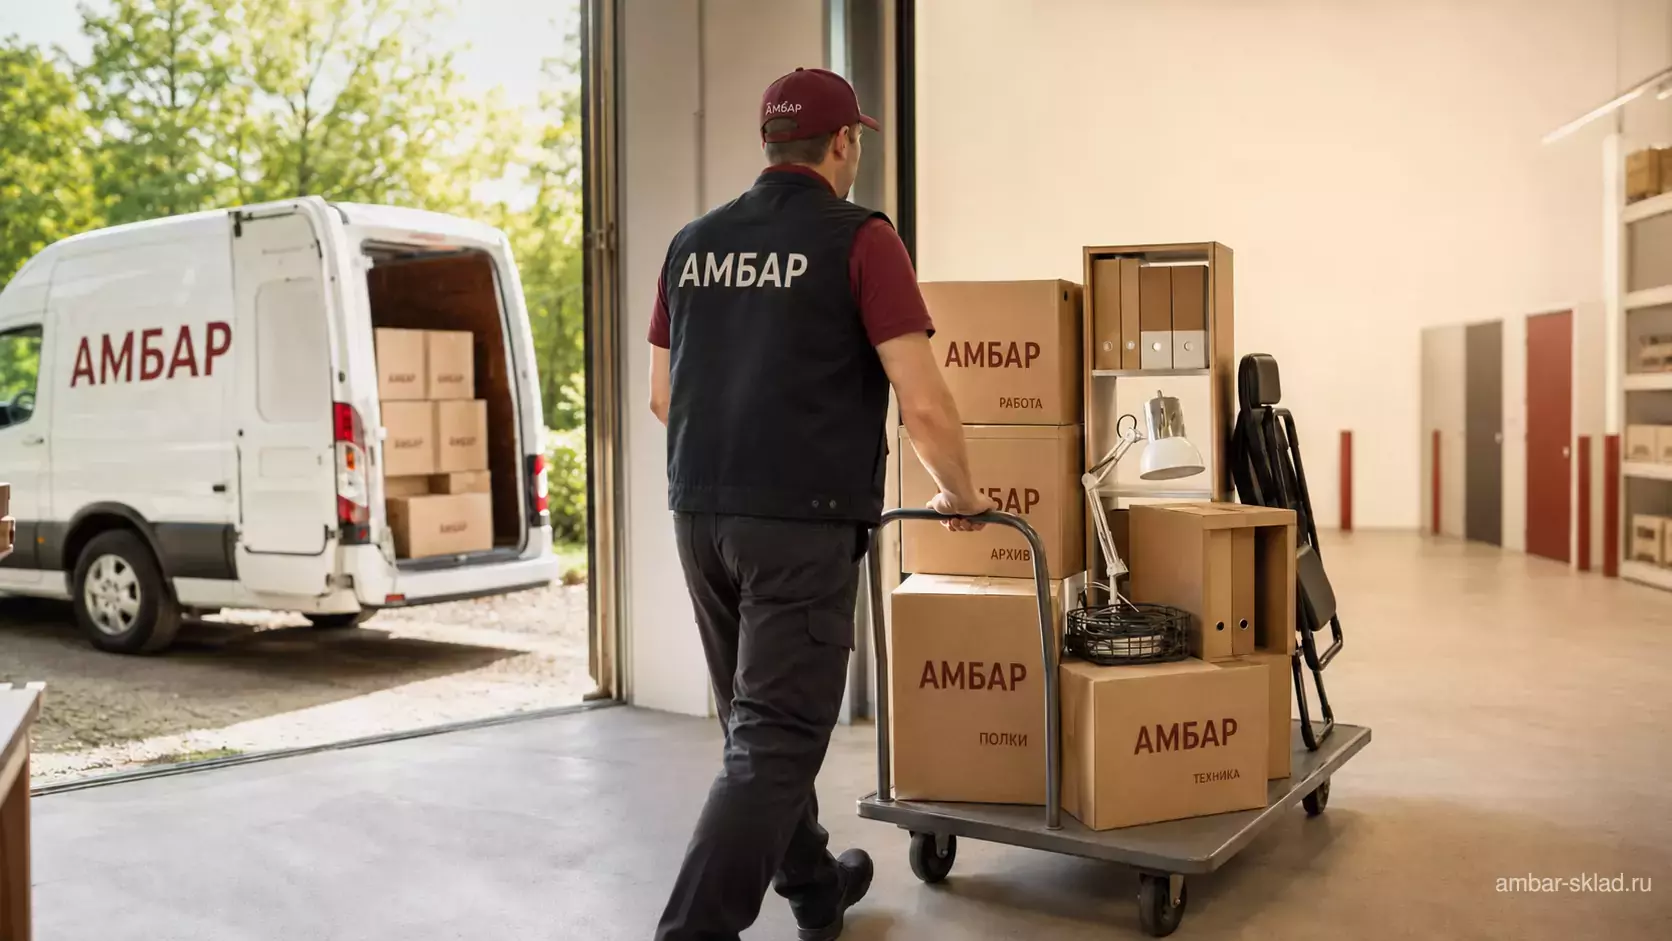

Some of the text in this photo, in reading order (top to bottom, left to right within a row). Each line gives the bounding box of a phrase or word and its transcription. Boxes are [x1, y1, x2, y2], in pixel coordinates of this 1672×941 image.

[678, 252, 808, 288] АМБАР
[70, 320, 232, 388] АМБАР
[945, 341, 1040, 368] АМБАР
[999, 397, 1043, 409] РАБОТА
[979, 487, 1040, 514] БАР
[990, 548, 1031, 561] АРХИВ
[918, 660, 1027, 691] АМБАР
[979, 732, 1028, 747] ПОЛКИ
[1134, 718, 1238, 755] АМБАР
[1193, 769, 1240, 784] ТЕХНИКА
